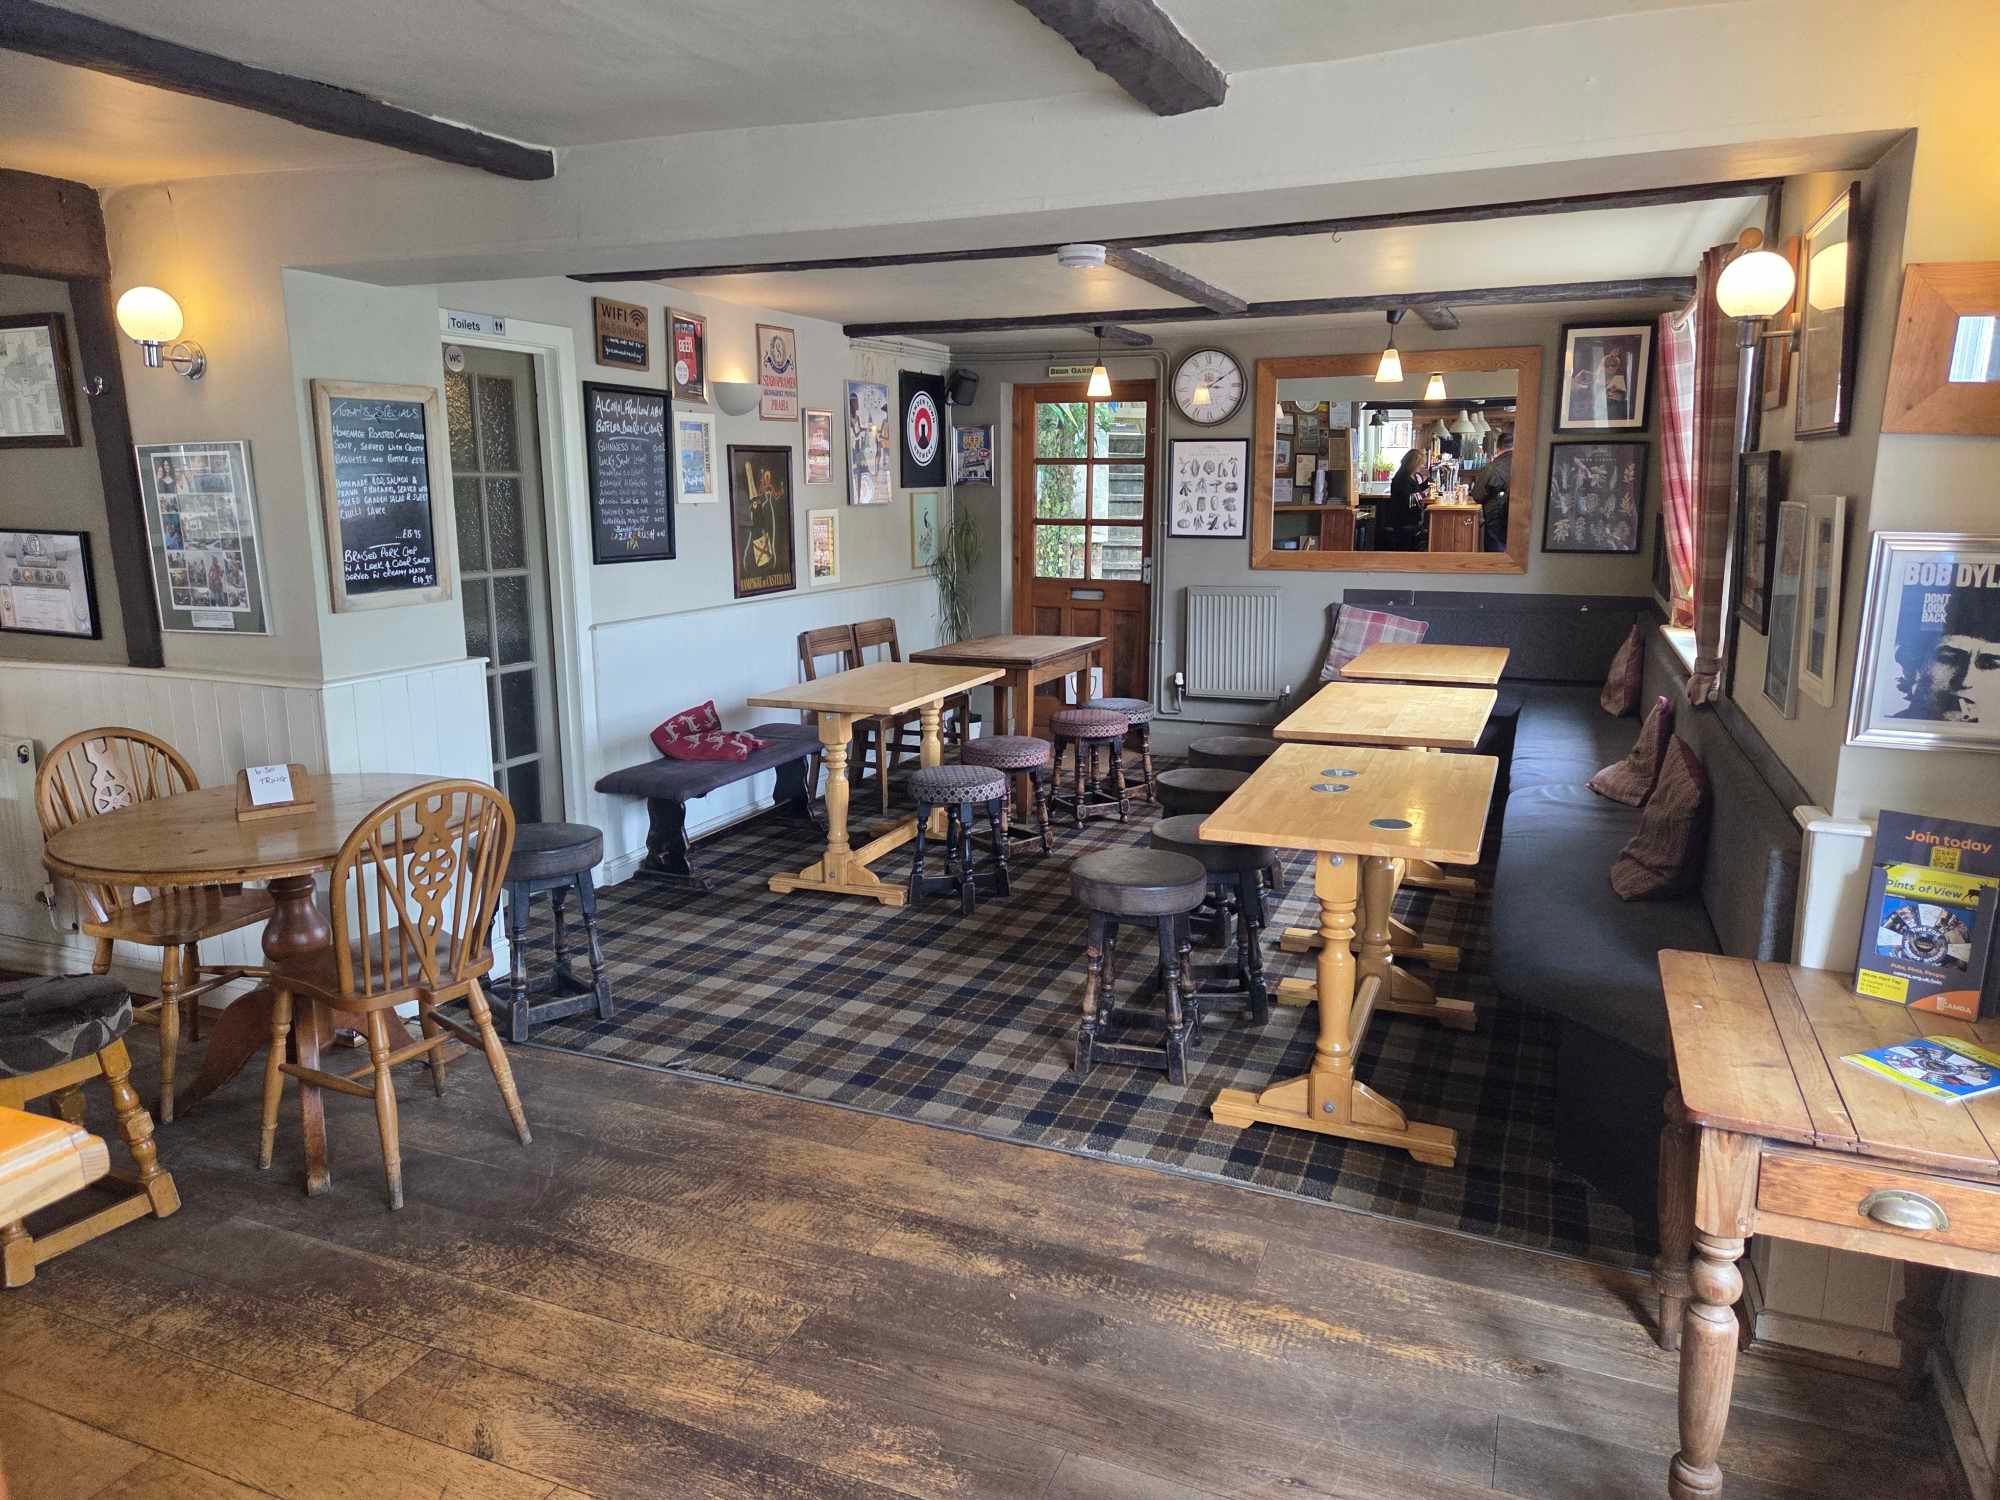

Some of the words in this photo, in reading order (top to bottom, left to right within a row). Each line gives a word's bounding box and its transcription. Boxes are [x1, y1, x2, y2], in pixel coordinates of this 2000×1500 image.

[601, 304, 627, 321] WIFI
[450, 317, 480, 331] Toilets
[449, 353, 463, 363] WC
[360, 442, 384, 451] SERVED
[598, 439, 629, 452] GUINNESS
[344, 549, 378, 563] BRAISED
[380, 546, 400, 558] PORK
[355, 563, 361, 571] A
[1904, 562, 1953, 587] BOB
[1956, 562, 2000, 588] DYL
[1923, 602, 1948, 613] LOOK
[1921, 612, 1948, 624] BACK
[1905, 829, 1940, 845] Join
[1943, 835, 1993, 855] today
[1918, 884, 1933, 893] of
[1934, 887, 1962, 899] View
